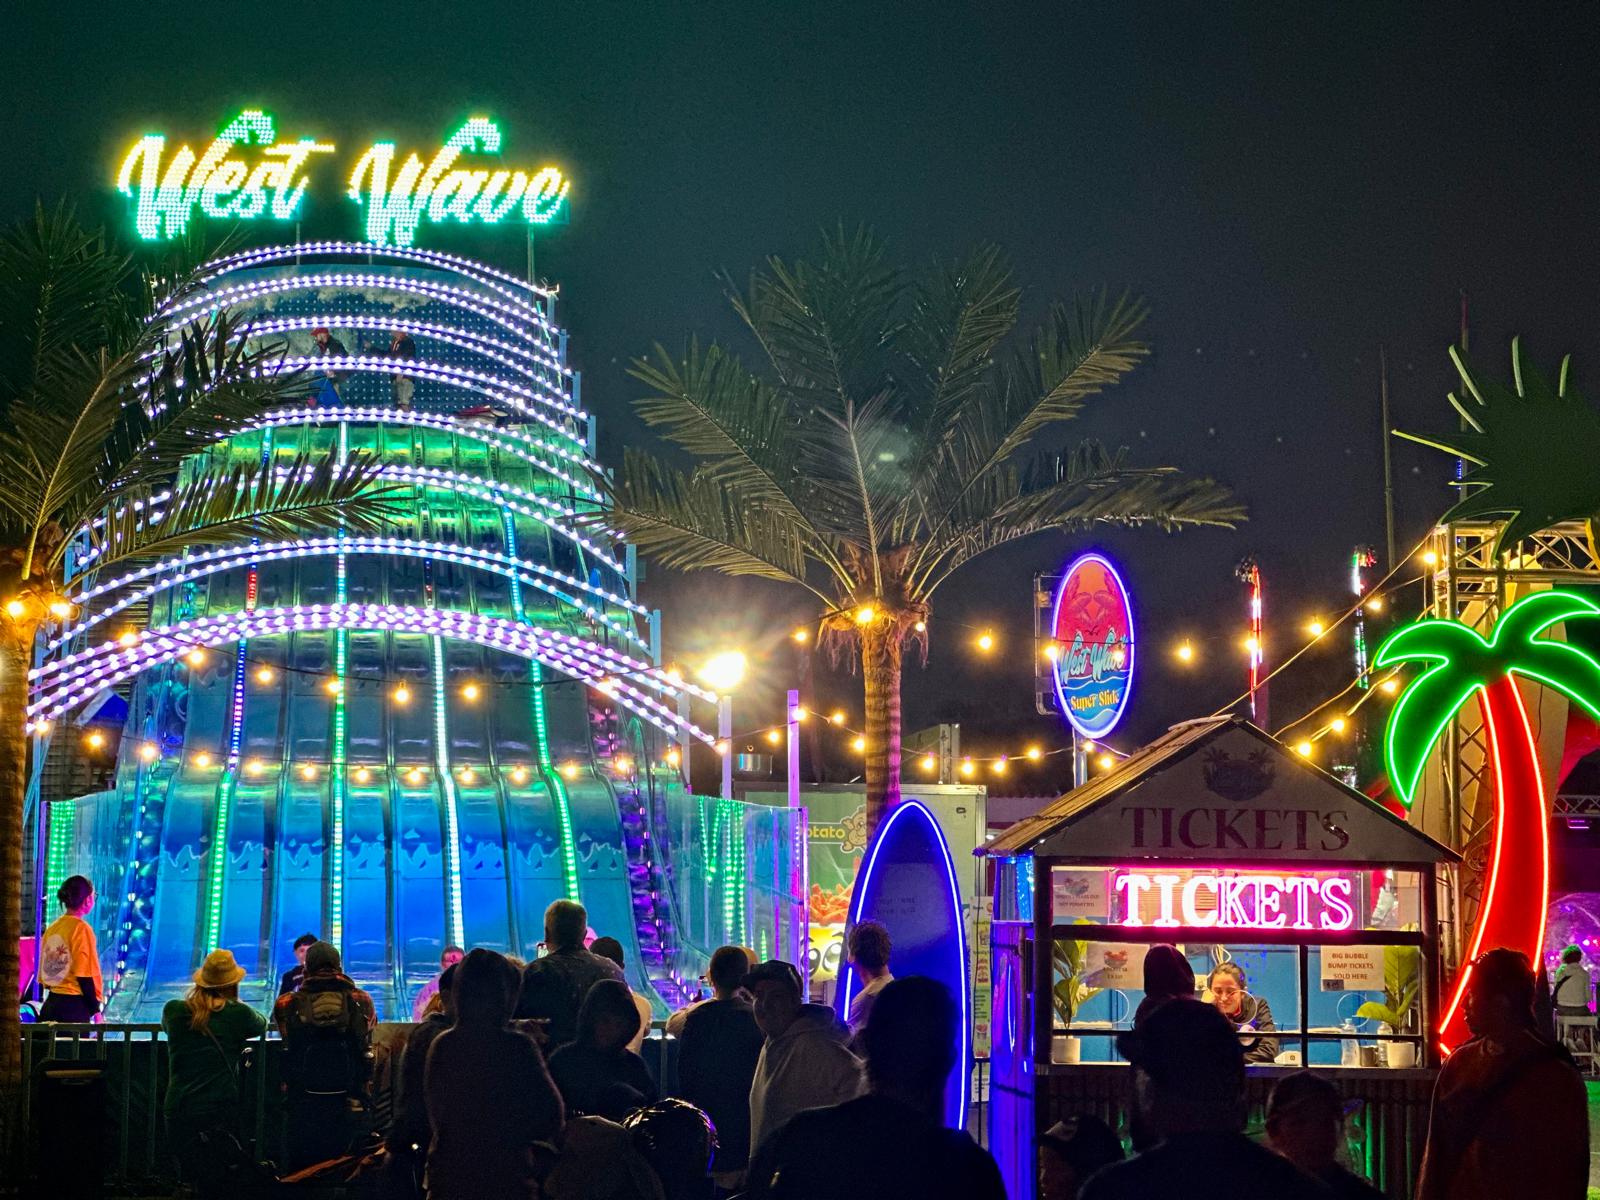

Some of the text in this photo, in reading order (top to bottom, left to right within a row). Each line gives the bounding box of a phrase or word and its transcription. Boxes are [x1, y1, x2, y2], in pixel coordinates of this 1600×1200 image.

[116, 109, 570, 246] West Wave
[1058, 630, 1090, 685] West
[1070, 689, 1120, 711] Super Slide
[1121, 807, 1350, 851] TICKETS
[1115, 874, 1353, 930] TICKETS
